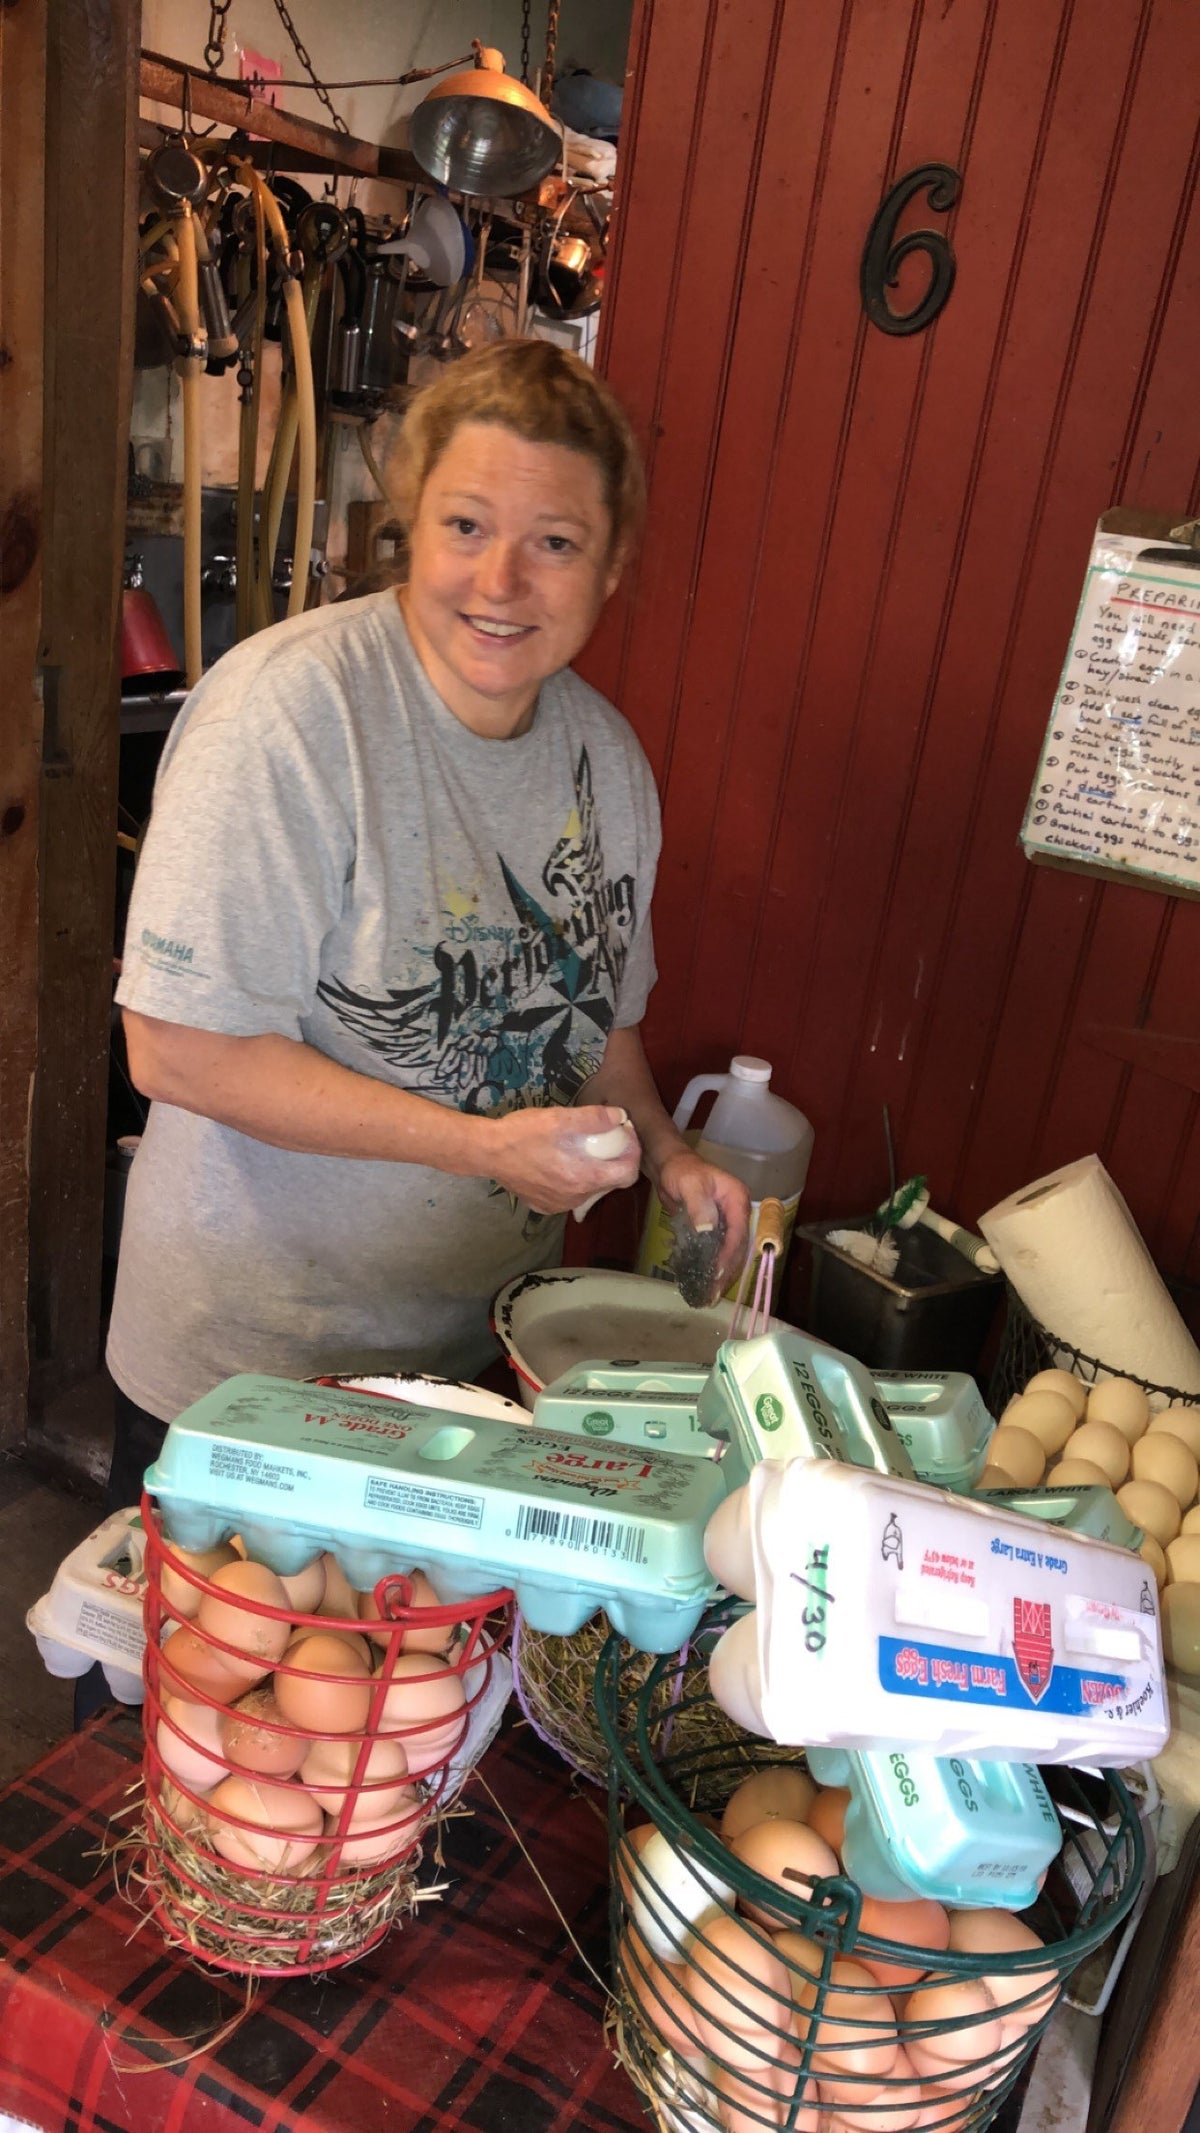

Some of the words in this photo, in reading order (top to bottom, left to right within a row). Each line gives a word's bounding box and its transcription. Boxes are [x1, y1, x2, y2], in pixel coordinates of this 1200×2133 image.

[860, 161, 962, 336] 6
[1098, 606, 1121, 620] You
[1161, 620, 1196, 634] need
[1092, 635, 1112, 650] egg
[1090, 652, 1133, 667] Gathr
[1079, 701, 1104, 711] Add
[1066, 761, 1090, 775] Put
[1141, 753, 1184, 771] gently
[1152, 769, 1187, 783] water
[1059, 788, 1080, 802] Full
[1161, 812, 1173, 823] to
[1053, 802, 1094, 820] Partial
[1101, 815, 1147, 834] cartons
[1152, 827, 1165, 838] to
[1050, 818, 1090, 836] Broken
[1095, 831, 1124, 846] eggs
[1184, 852, 1198, 862] to
[444, 913, 515, 944] Disney
[793, 1361, 811, 1380] 12
[904, 1372, 949, 1381] WHITE
[581, 1389, 633, 1399] EGGS
[801, 1382, 834, 1440] EGGS
[886, 1404, 927, 1413] GGS
[303, 1412, 336, 1426] AA
[688, 1415, 705, 1432] 1
[338, 1420, 407, 1440] Grade
[212, 1444, 252, 1459] DISTRIBUTED
[515, 1437, 571, 1453] EGGS
[211, 1452, 244, 1466] WEGMANS
[245, 1458, 262, 1469] FOOD
[545, 1452, 654, 1479] Large
[209, 1467, 225, 1477] VISIT
[226, 1471, 235, 1480] US
[236, 1473, 245, 1481] AT
[250, 1467, 259, 1476] NY
[370, 1479, 388, 1488] SAFE
[389, 1482, 424, 1495] HANDLING
[532, 1474, 619, 1498] Wegmans
[986, 1487, 1039, 1497] LARGE
[1045, 1485, 1094, 1494] WHITE
[505, 1528, 512, 1537] 0
[531, 1533, 574, 1550] 77890
[583, 1543, 627, 1561] 80133
[991, 1537, 1014, 1561] Large
[1015, 1548, 1036, 1568] Extra
[1036, 1556, 1044, 1569] A
[1045, 1559, 1068, 1575] Grade
[920, 1564, 960, 1585] Refrigerated
[789, 1549, 836, 1653] 4/30
[894, 1646, 930, 1686] Eggs
[931, 1658, 970, 1691] Fresh
[971, 1665, 1008, 1696] Farm
[889, 1753, 920, 1807] EGGS
[950, 1758, 979, 1813] GGS
